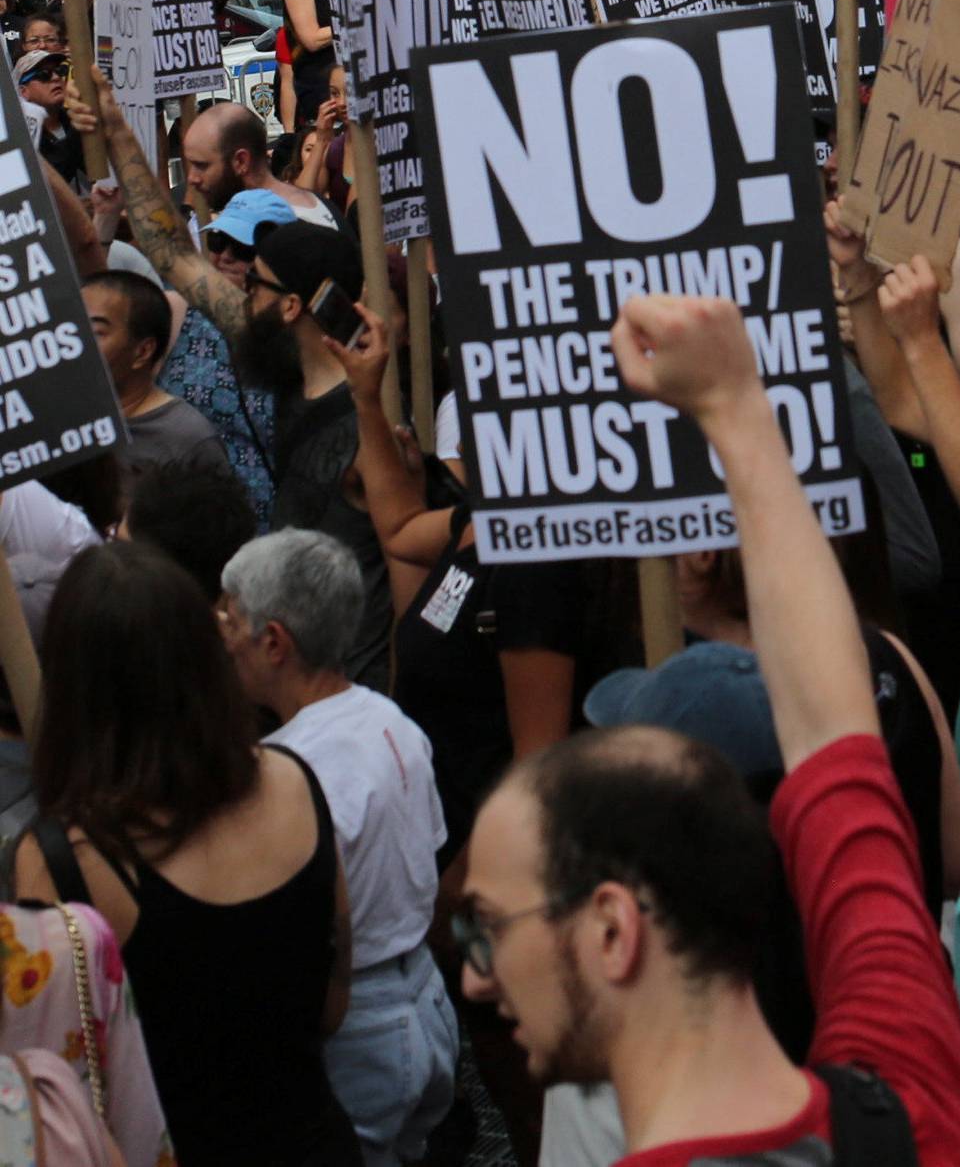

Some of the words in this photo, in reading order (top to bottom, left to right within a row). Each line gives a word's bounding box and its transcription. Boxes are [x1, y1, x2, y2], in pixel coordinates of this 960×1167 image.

[110, 7, 142, 39] MUST
[478, 0, 505, 31] ¡EL
[196, 29, 223, 66] GO!
[428, 24, 795, 255] NO!
[27, 242, 57, 284] A
[479, 263, 577, 330] THE
[471, 401, 678, 500] MUST
